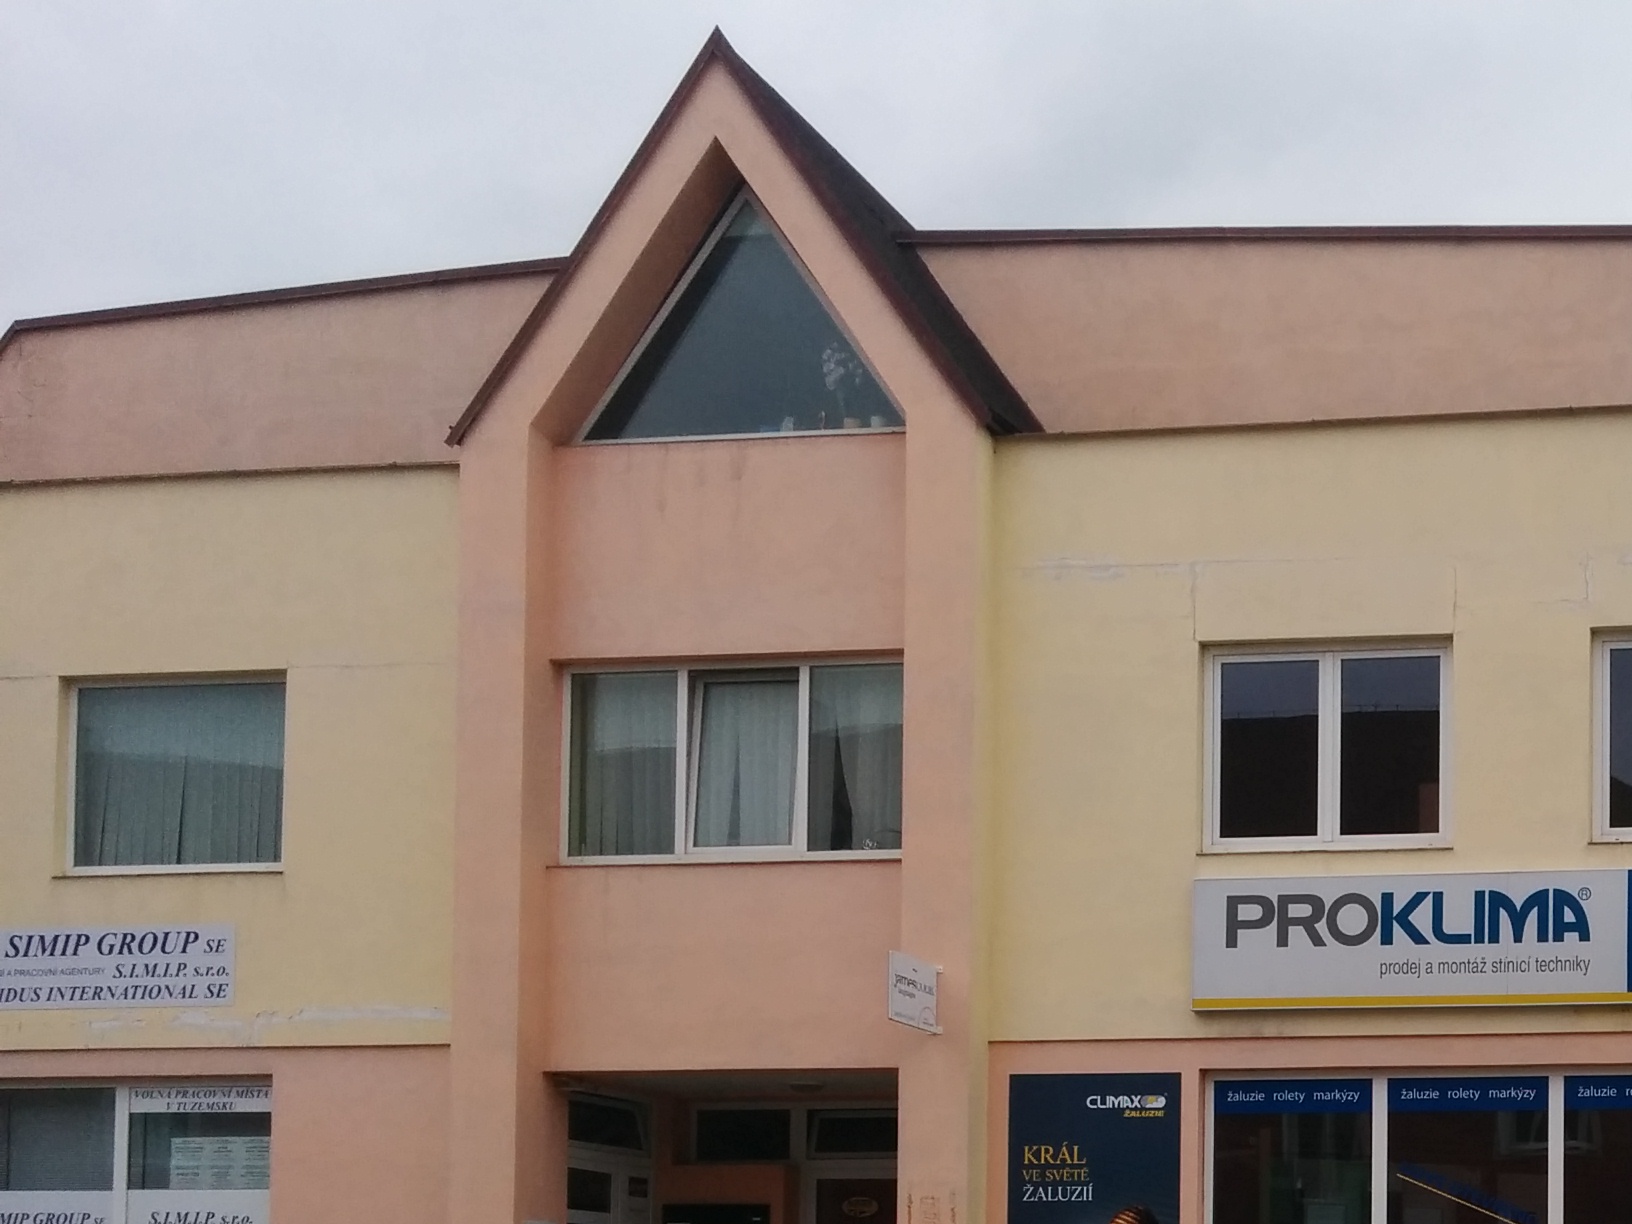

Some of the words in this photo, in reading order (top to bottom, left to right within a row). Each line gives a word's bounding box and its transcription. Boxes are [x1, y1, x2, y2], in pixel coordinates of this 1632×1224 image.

[1225, 888, 1591, 948] PROKLIMA
[4, 934, 90, 958] SIMIP
[97, 931, 199, 956] GROUP
[203, 938, 227, 954] SE
[58, 967, 105, 977] AGENTURY
[112, 962, 187, 979] S.I.M.I.P.
[192, 965, 230, 977] s.r.o.
[1379, 958, 1421, 979] prodej
[1425, 962, 1433, 975] a
[1437, 957, 1487, 975] montáž
[1535, 955, 1591, 976] techniky
[46, 984, 199, 1002] INTERNATIONAL
[203, 983, 229, 999] SE
[175, 1086, 232, 1099] PRACOVNÍ
[1227, 1090, 1266, 1102] žaluzie
[1273, 1090, 1306, 1103] rolety
[1313, 1089, 1361, 1103] markýzy
[1400, 1088, 1440, 1099] žaluzie
[1447, 1087, 1481, 1101] rolety
[1488, 1086, 1537, 1100] markýzy
[1577, 1085, 1618, 1097] žaluzie
[166, 1102, 174, 1111] V
[177, 1101, 237, 1111] TUZEMSKU
[1086, 1095, 1141, 1108] CLIMAX
[1023, 1141, 1087, 1164] KRÁL
[1022, 1169, 1041, 1181] VE
[1022, 1183, 1093, 1201] ŽALUZIÍ
[220, 1213, 253, 1224] s.r.o.
